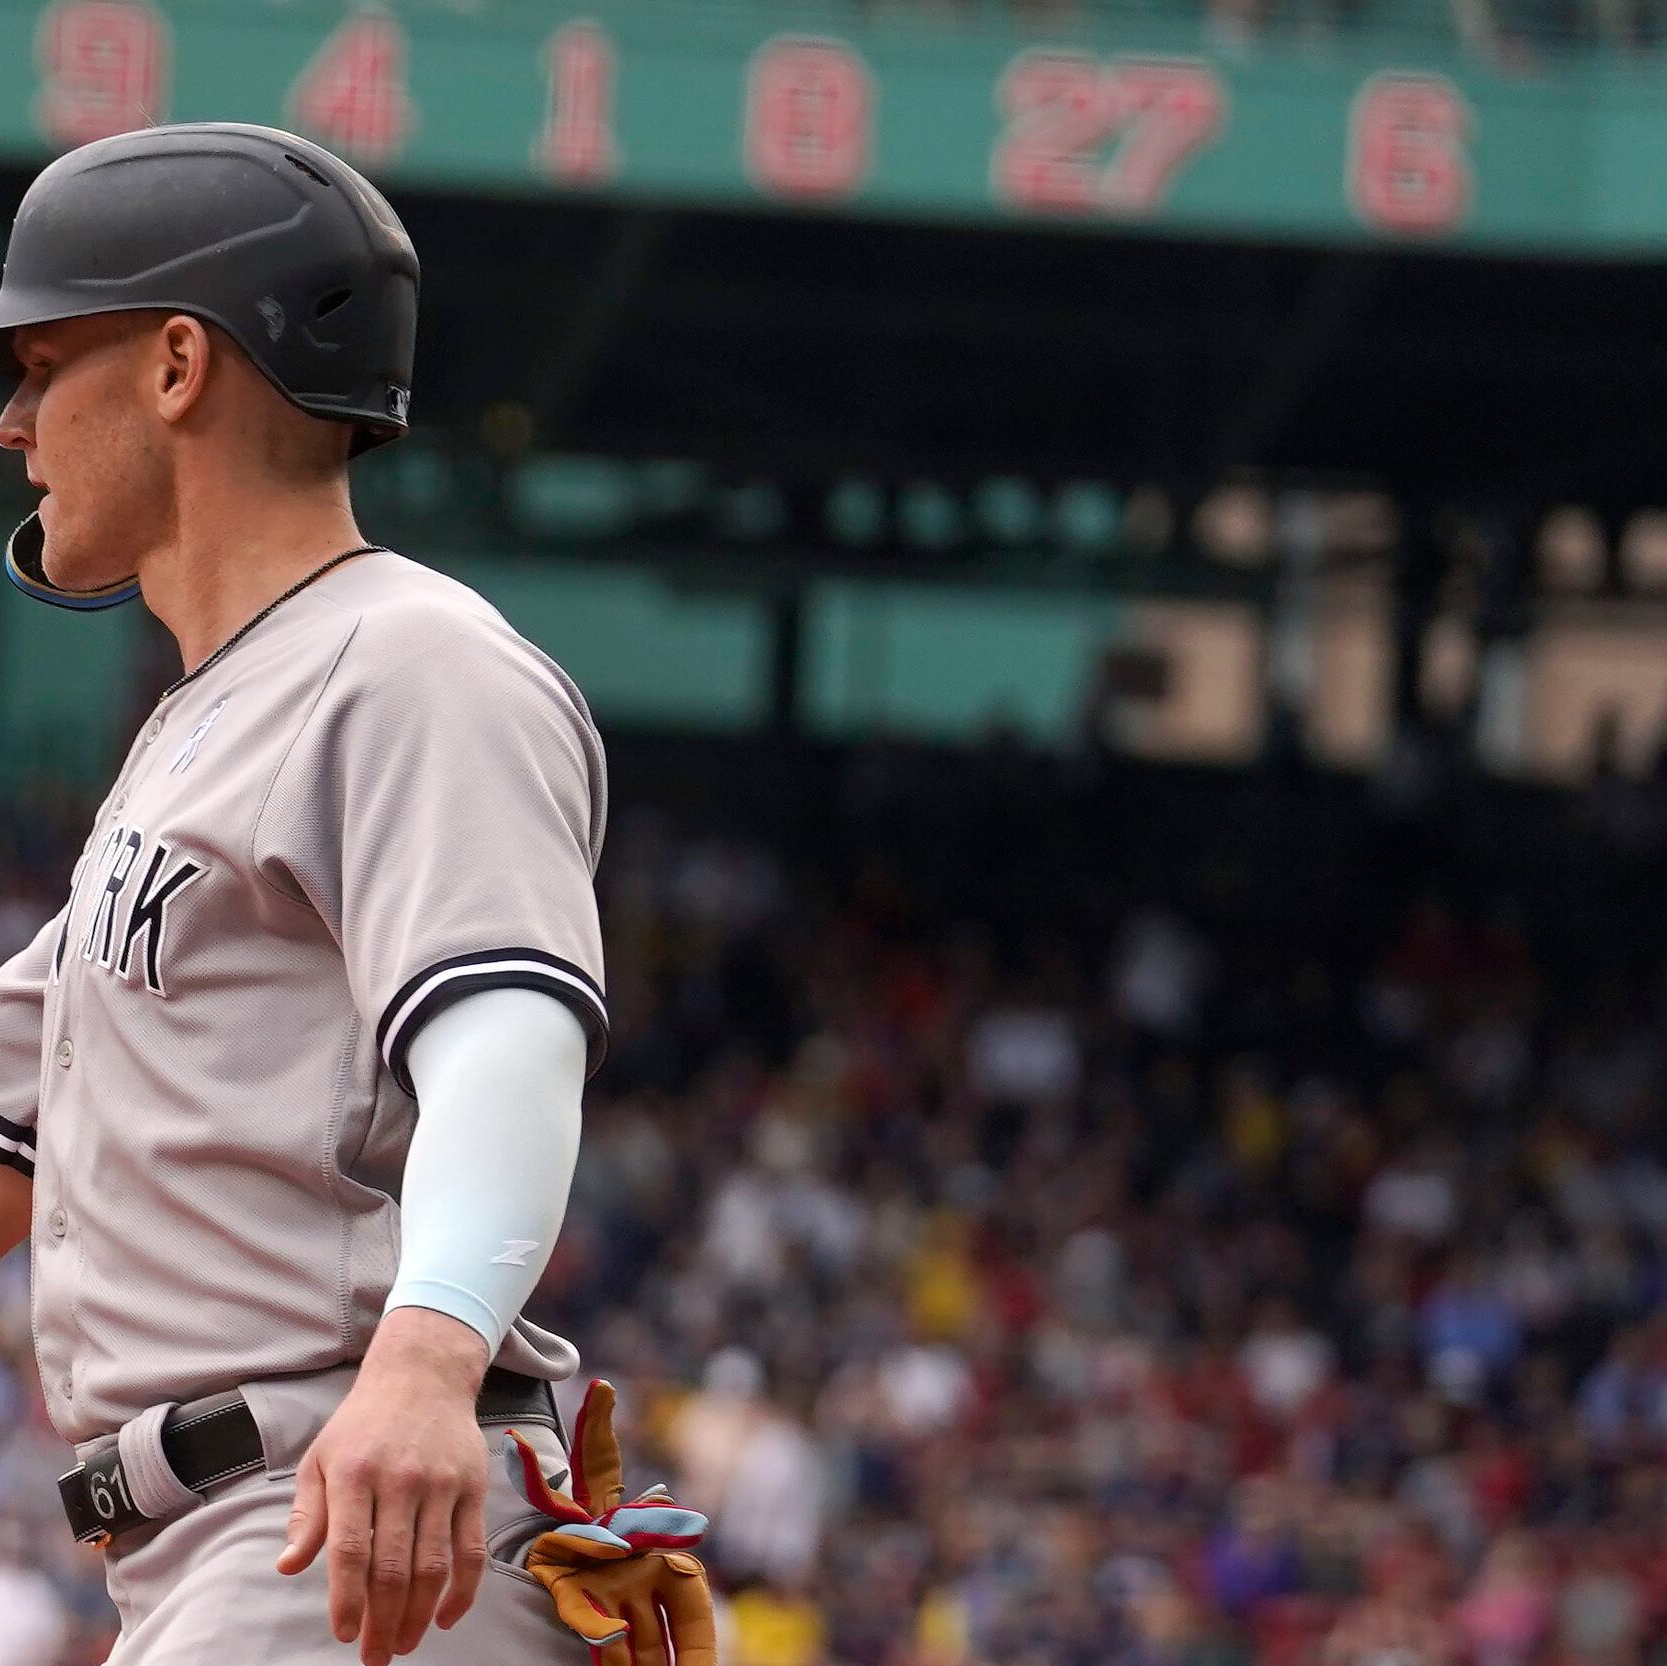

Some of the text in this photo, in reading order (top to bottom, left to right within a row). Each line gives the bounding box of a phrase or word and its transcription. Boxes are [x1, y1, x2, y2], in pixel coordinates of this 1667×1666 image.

[291, 10, 417, 165] 4
[533, 22, 621, 186] 1
[991, 50, 1229, 212] 27
[1349, 72, 1475, 232] 6
[90, 1464, 132, 1519] 61
